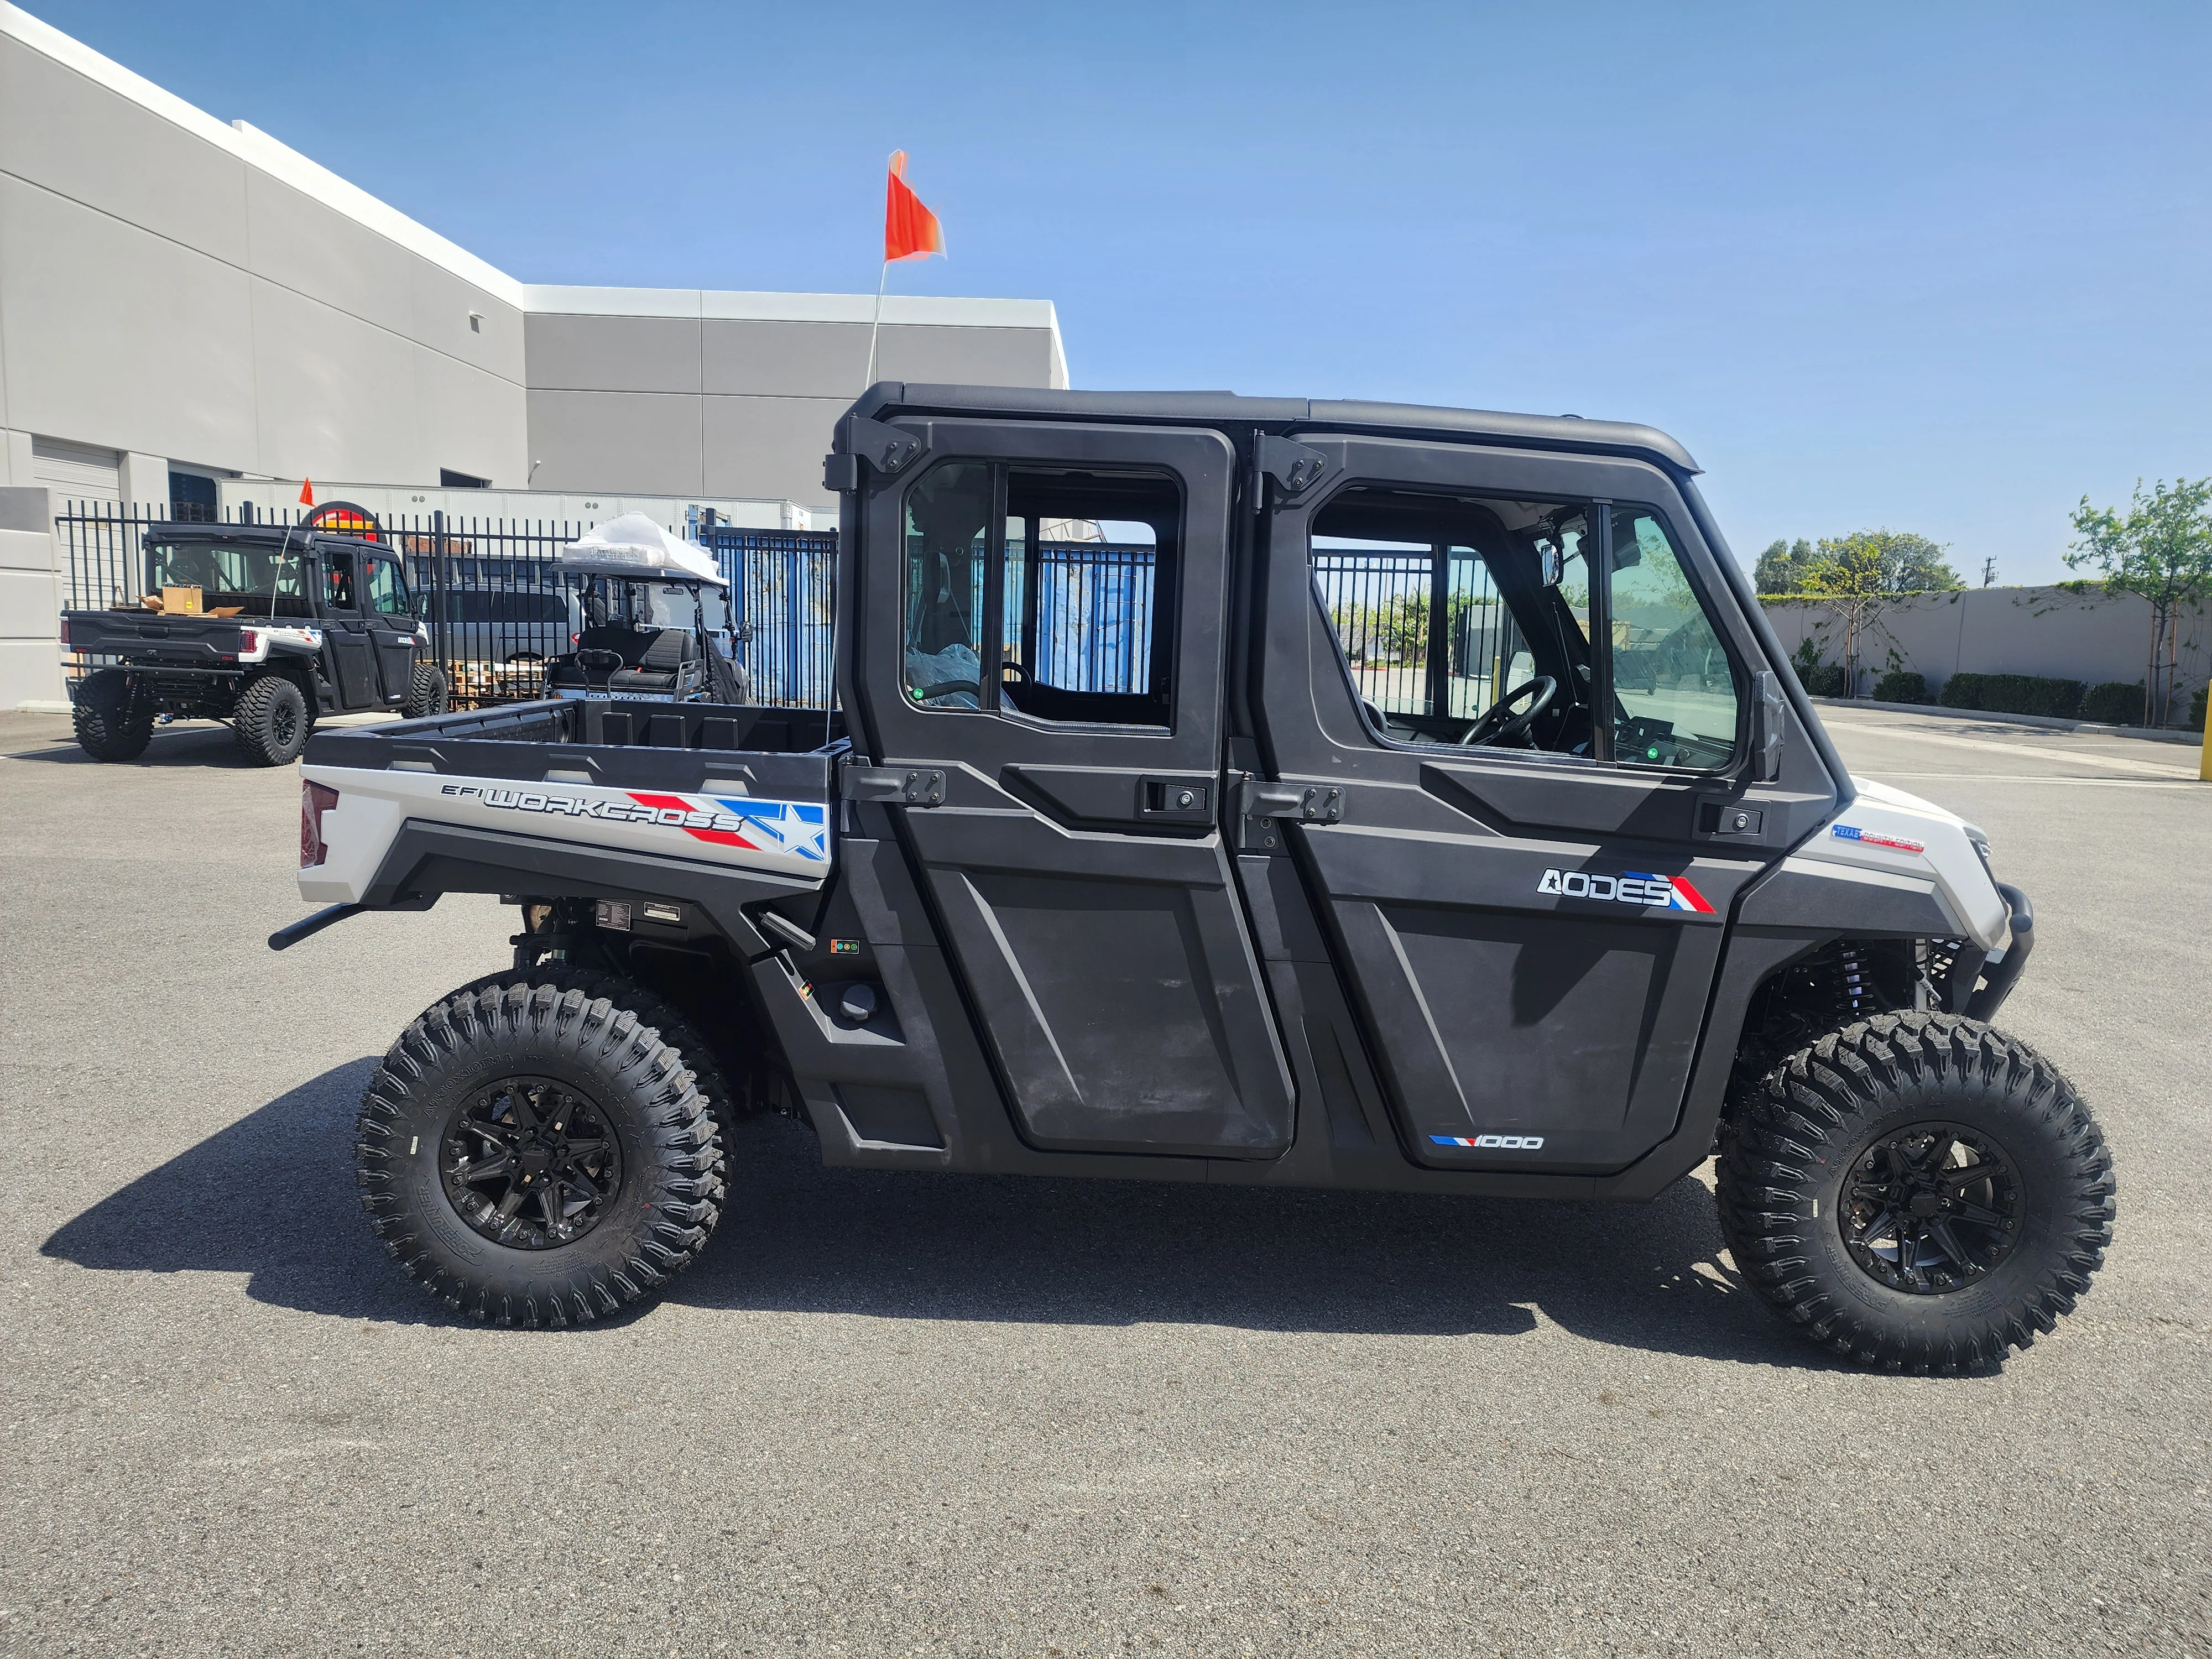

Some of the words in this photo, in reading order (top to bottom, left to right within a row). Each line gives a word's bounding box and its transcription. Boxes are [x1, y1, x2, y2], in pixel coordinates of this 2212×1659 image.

[440, 784, 484, 799] EFI
[483, 789, 748, 832] WORKCROSS
[1837, 826, 1859, 838] TEXAS
[1864, 832, 1894, 844] BOUNTY
[1895, 838, 1923, 851] EDITION
[1536, 868, 1673, 907] AODES
[1473, 1135, 1545, 1150] 1000
